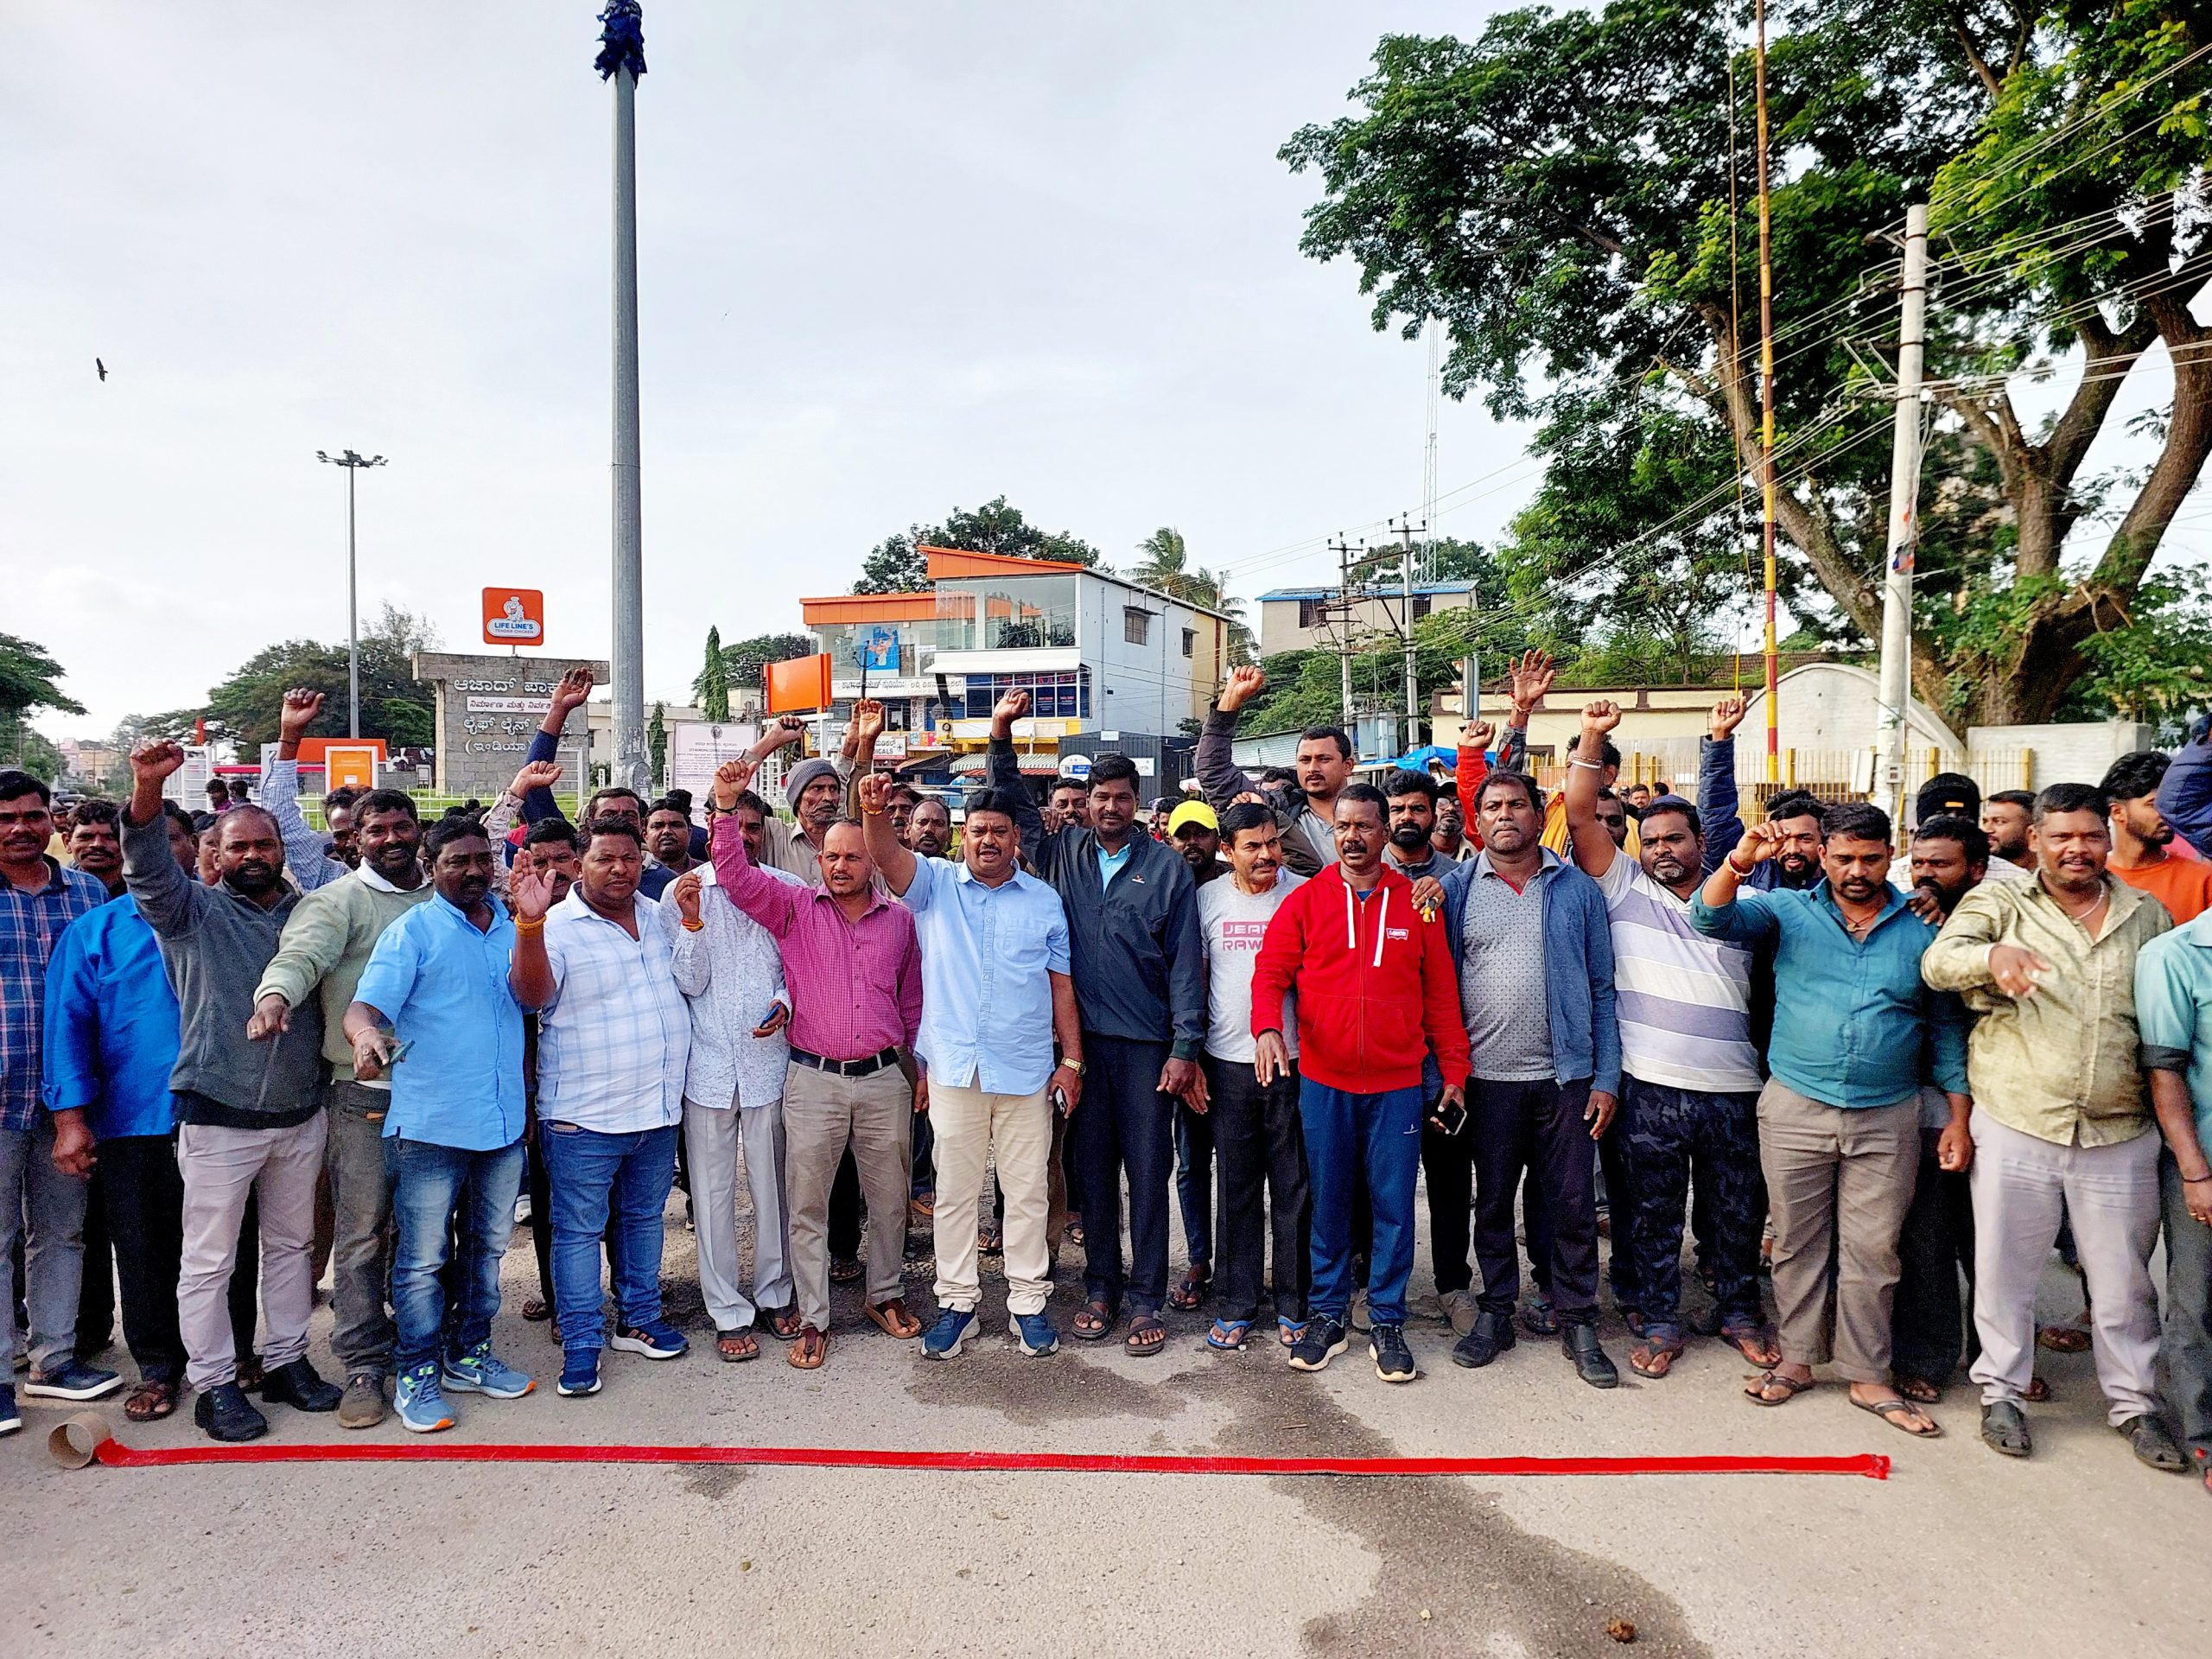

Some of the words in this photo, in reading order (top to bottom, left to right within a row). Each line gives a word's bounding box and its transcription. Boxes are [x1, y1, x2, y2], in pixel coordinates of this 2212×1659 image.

[454, 677, 517, 692] ಆಜಾದ್
[469, 700, 504, 709] ನಿರ್ಮಾಣ
[506, 701, 525, 711] ಮತ್ತು
[463, 715, 496, 735] ಲೈಫ್
[500, 716, 531, 735] ಲೈನ್
[1223, 939, 1263, 951] RAW
